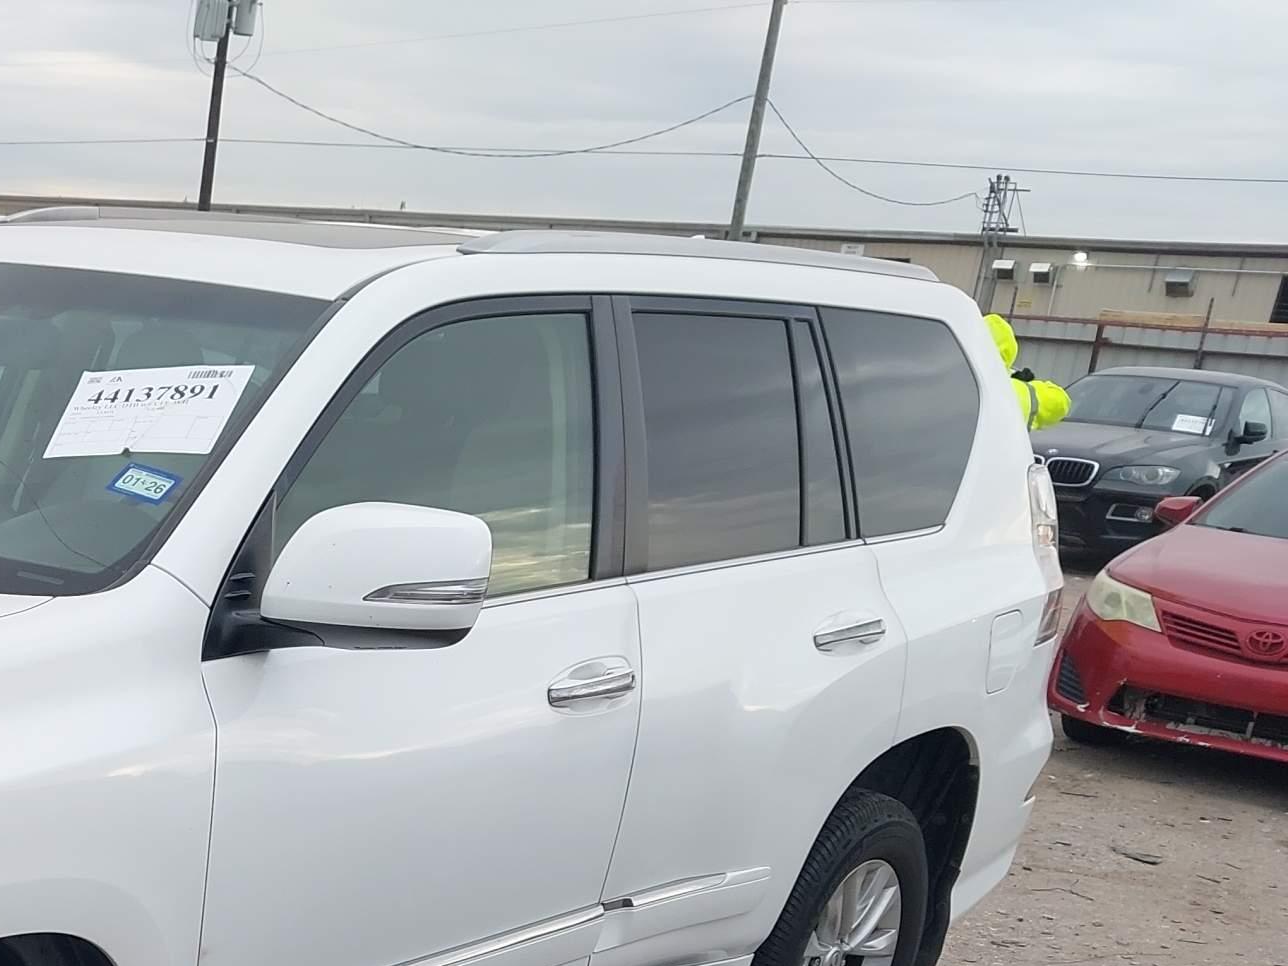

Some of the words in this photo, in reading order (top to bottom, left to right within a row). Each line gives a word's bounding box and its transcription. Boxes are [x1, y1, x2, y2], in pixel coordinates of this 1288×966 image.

[87, 383, 220, 405] 44137891
[121, 474, 142, 488] 01
[144, 480, 167, 495] 26
